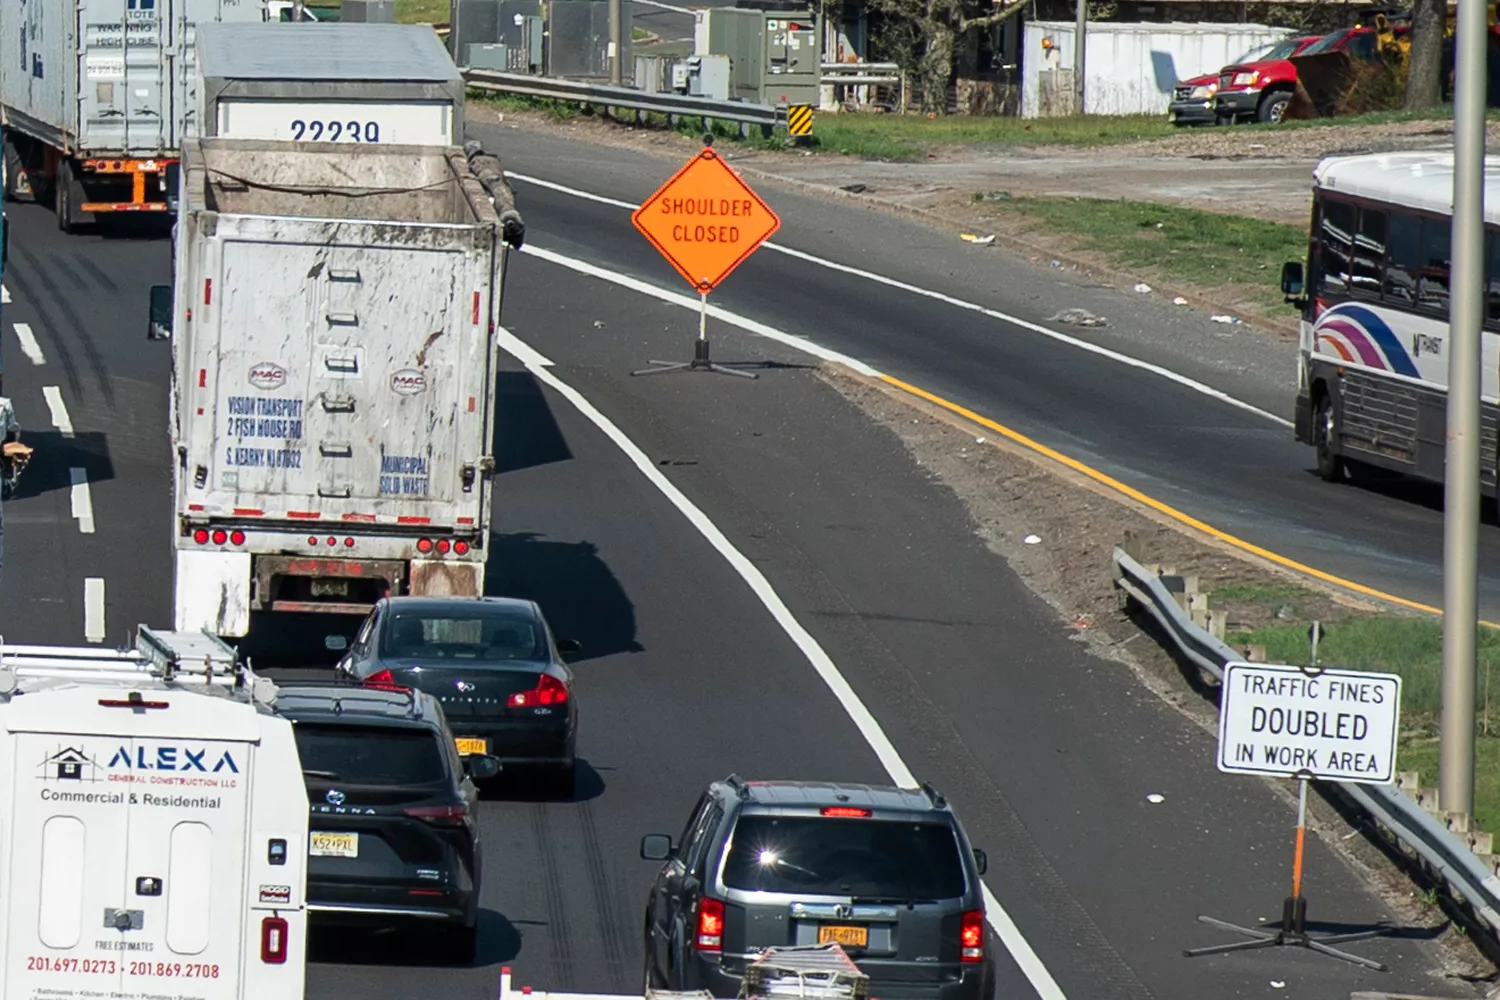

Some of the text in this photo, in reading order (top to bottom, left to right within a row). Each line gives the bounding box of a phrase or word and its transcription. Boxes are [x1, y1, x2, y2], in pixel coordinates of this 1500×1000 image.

[128, 10, 155, 19] TOTE
[127, 37, 156, 46] CUBE
[660, 197, 753, 217] SHOULDER
[672, 224, 740, 243] CLOSED
[251, 369, 282, 380] MAC
[393, 376, 424, 386] MAC
[227, 396, 304, 418] VISION TRANSPORT
[227, 417, 234, 436] 2
[235, 418, 256, 437] FISH
[257, 419, 288, 438] HOUSE
[382, 455, 427, 474] MUNICIPAL
[379, 476, 429, 496] SOLID WASTE
[1243, 674, 1385, 705] TRAFFIC FINES
[1251, 706, 1368, 741] DOUBLED
[107, 745, 240, 774] ALEXA
[1235, 743, 1379, 773] IN WORK AREA
[107, 773, 237, 789] GENERAL CONSTRUCTION LLC
[40, 788, 221, 809] Commercial & Residential
[94, 940, 154, 952] FREE ESTIMATES
[27, 956, 220, 979] 201.697.0273 201.869.2708
